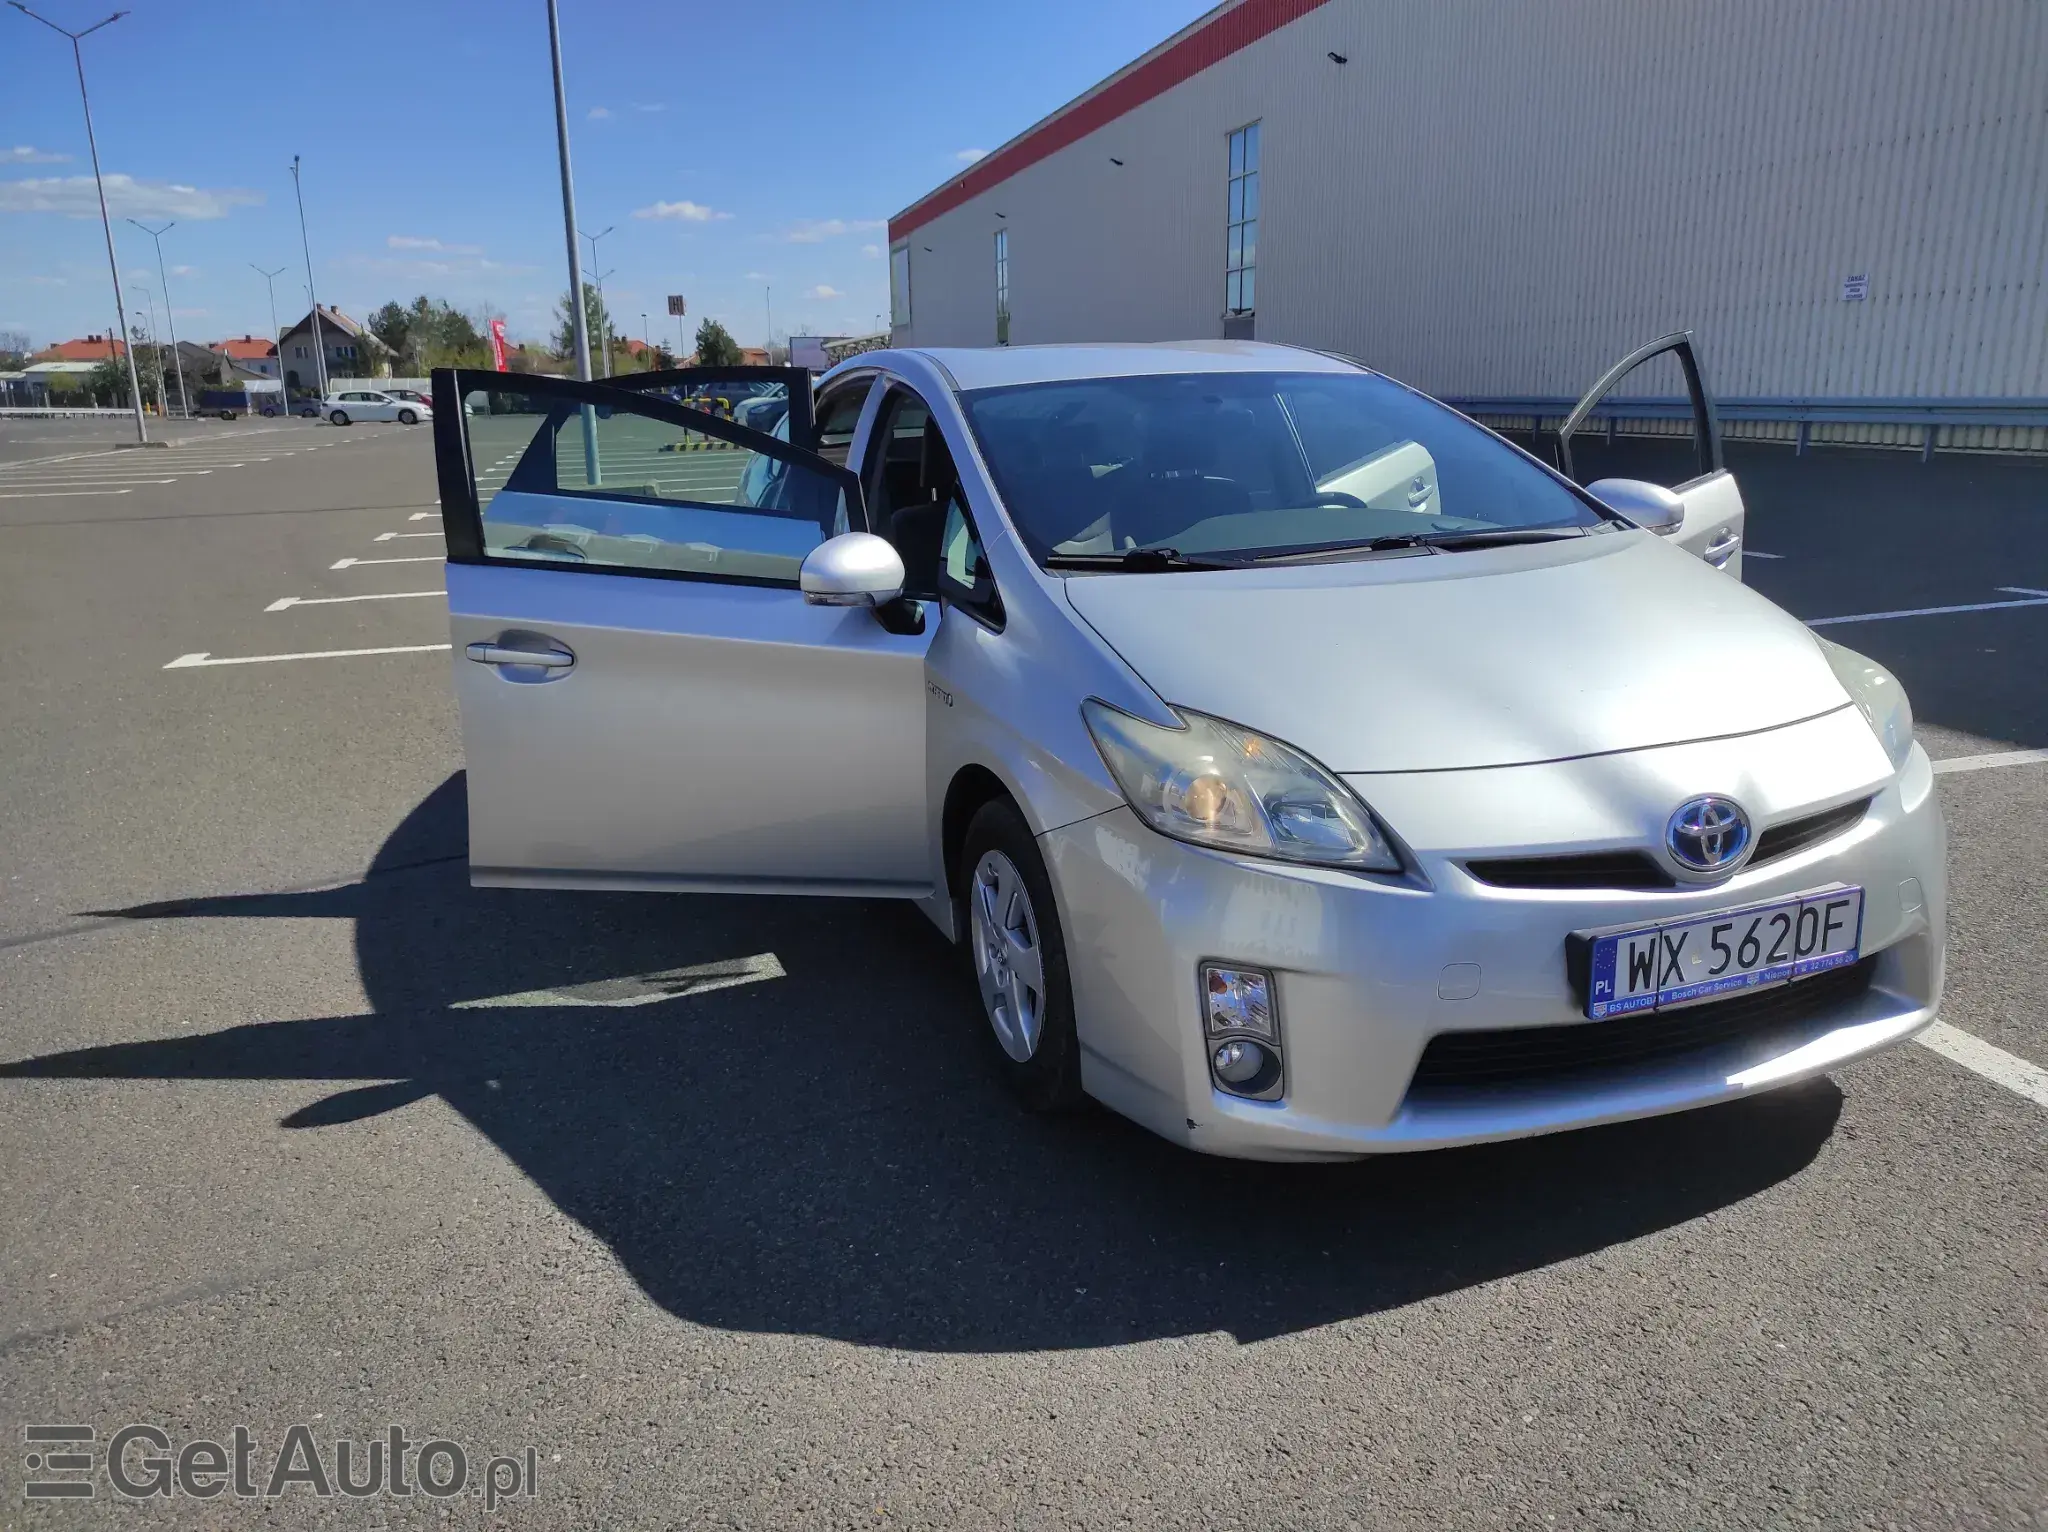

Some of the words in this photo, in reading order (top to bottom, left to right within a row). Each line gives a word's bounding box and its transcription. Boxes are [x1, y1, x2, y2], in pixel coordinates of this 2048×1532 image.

[1629, 931, 1689, 993] WX
[1708, 899, 1851, 975] 5620F
[1595, 980, 1612, 995] PL
[1671, 988, 1697, 1000] Bosch
[1698, 985, 1712, 995] Car
[1713, 979, 1743, 992] Service
[1764, 968, 1797, 980] Nieport
